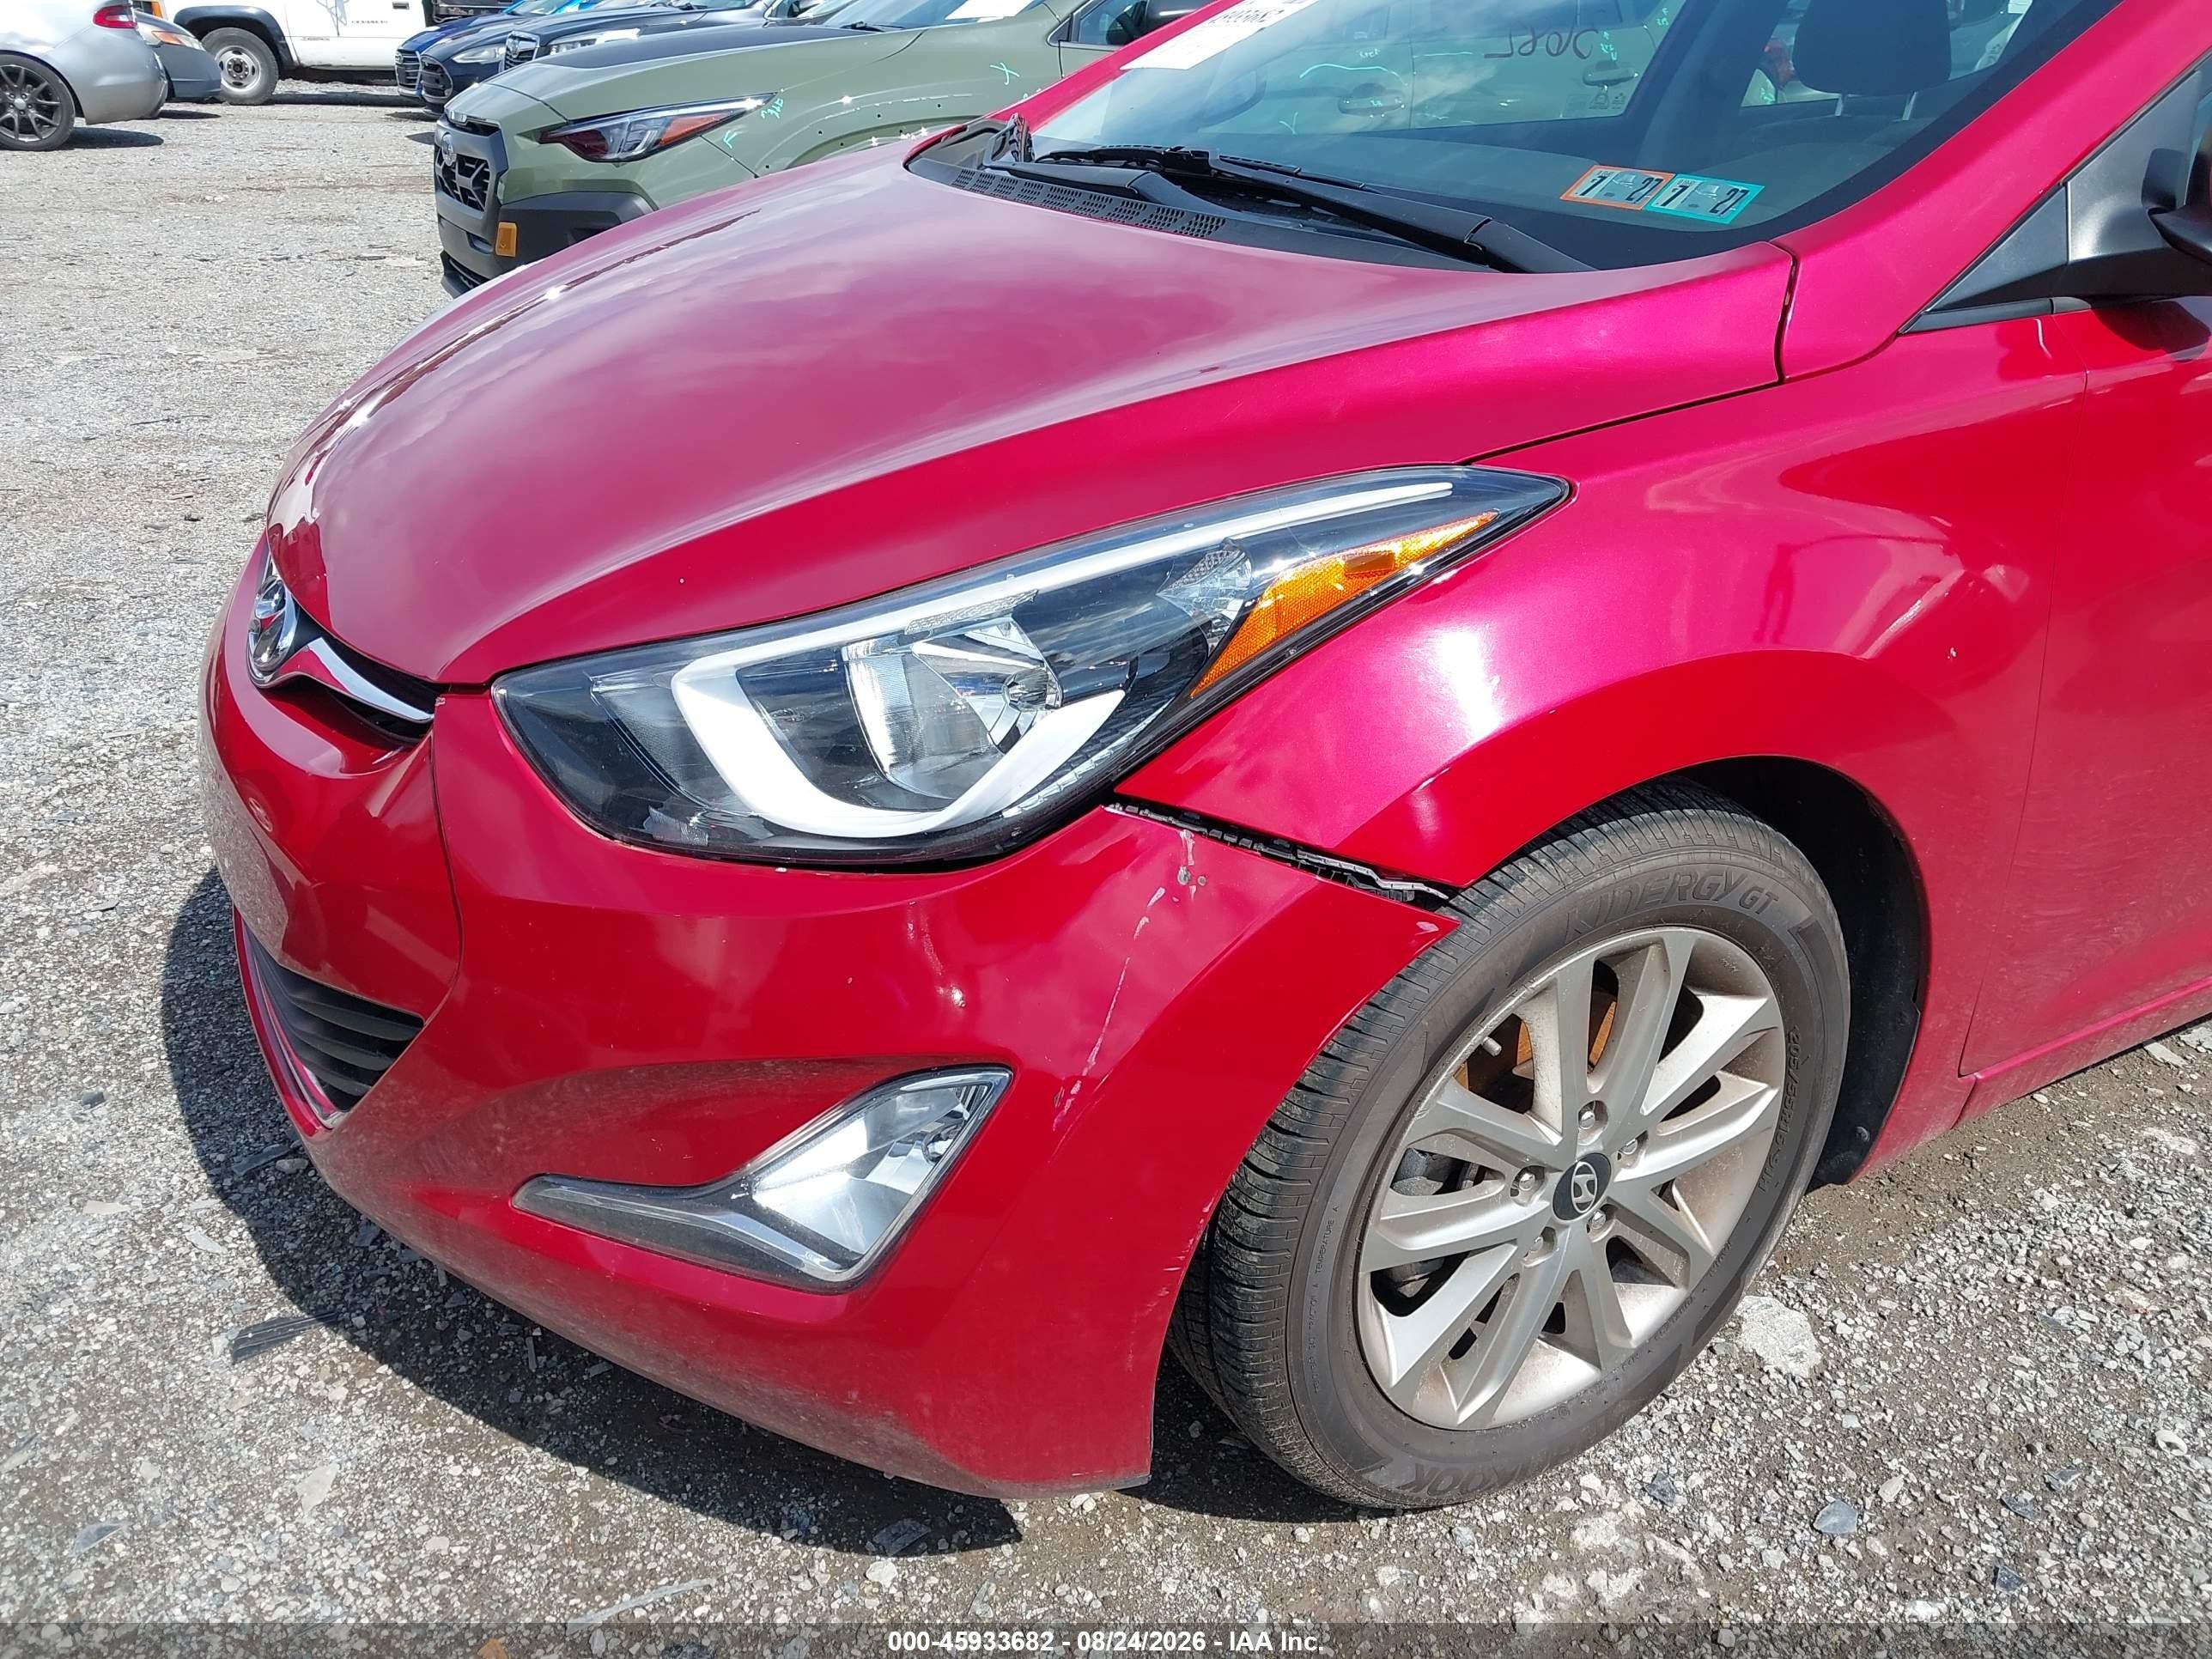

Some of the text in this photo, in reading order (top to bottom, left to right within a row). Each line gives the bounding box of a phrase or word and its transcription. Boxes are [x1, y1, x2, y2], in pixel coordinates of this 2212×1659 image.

[1580, 175, 1607, 196] 7
[1626, 177, 1664, 204] 27
[1661, 185, 1689, 207] 7
[1710, 188, 1750, 215] 27
[1739, 885, 1779, 915] GT
[1315, 1218, 1334, 1273] TEMPERATURE
